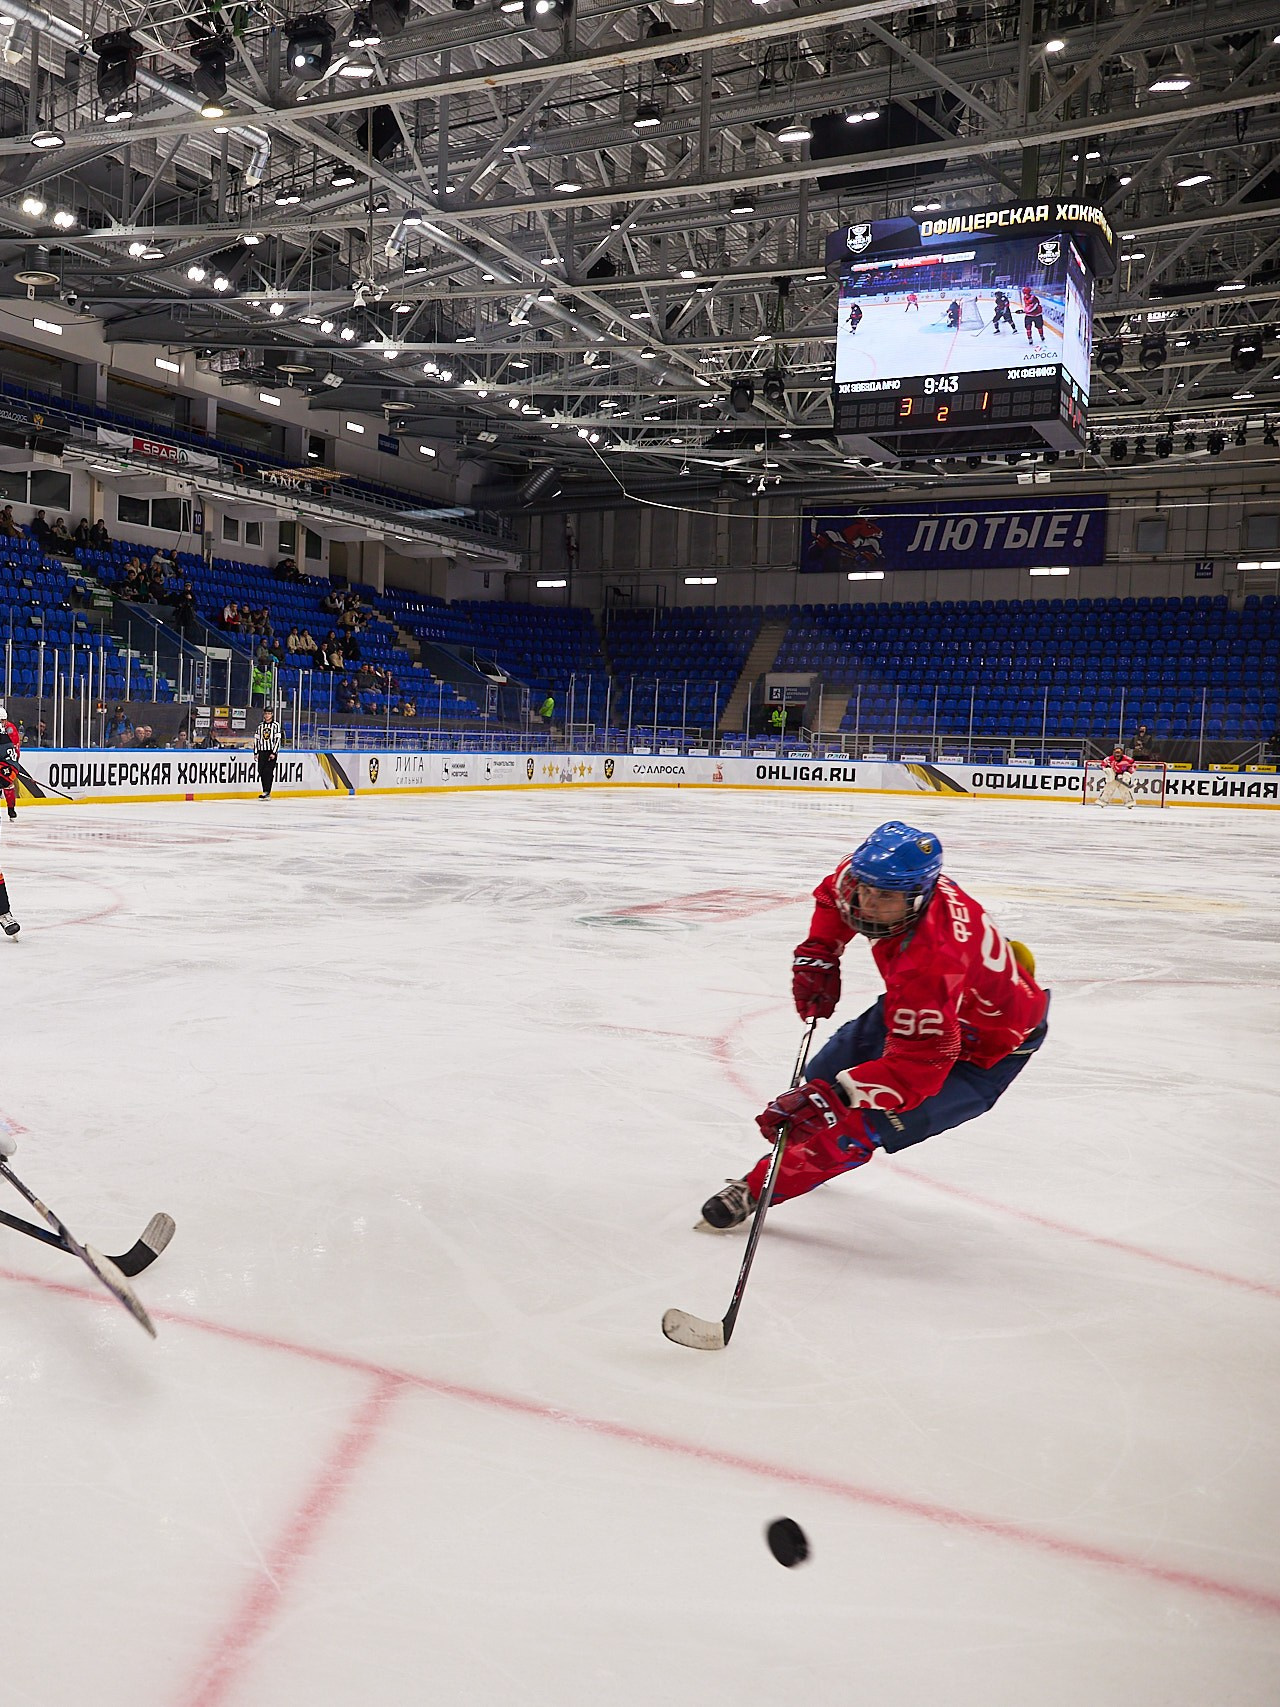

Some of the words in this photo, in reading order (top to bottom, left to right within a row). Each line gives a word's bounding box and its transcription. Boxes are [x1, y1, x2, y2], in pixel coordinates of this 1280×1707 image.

[921, 203, 1050, 237] ОФИЦЕРСКАЯ
[923, 375, 960, 395] 9:43
[899, 397, 913, 417] 3
[937, 406, 949, 422] 2
[143, 441, 177, 463] SPAR
[258, 469, 301, 492] TANK
[195, 513, 202, 526] 10
[907, 514, 1090, 552] ЛЮТЫЕ!
[49, 762, 171, 789] ОФИЦЕРСКАЯ
[177, 756, 262, 786] ХОККЕЙНА
[395, 756, 424, 772] ЛИГА
[756, 764, 856, 782] OHLIGA.RU
[972, 772, 1109, 792] ОФИЦЕРСКА
[1133, 775, 1279, 799] ХОККЕЙНАЯ
[793, 956, 835, 970] CM
[892, 1008, 945, 1036] 92
